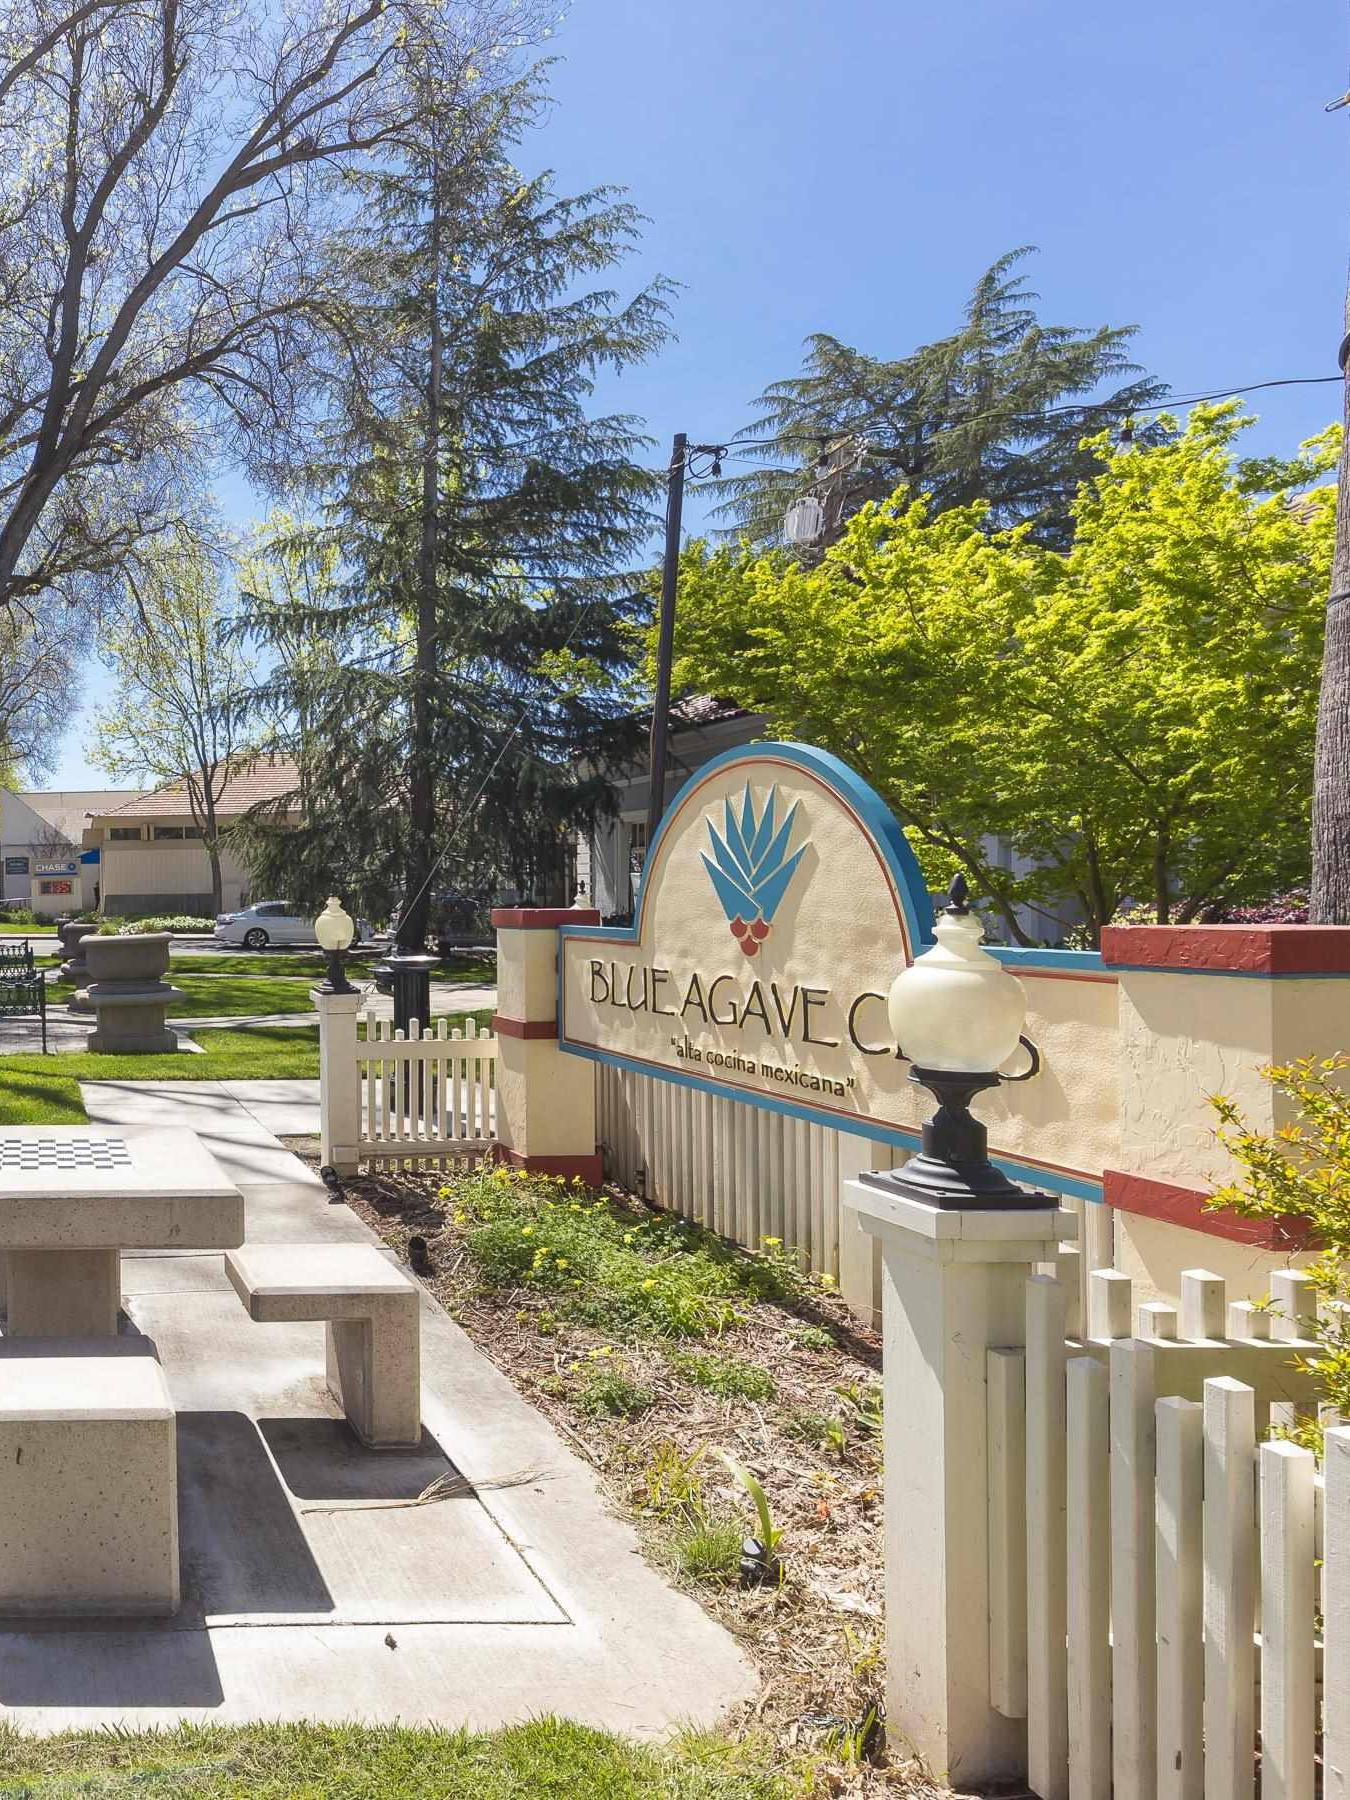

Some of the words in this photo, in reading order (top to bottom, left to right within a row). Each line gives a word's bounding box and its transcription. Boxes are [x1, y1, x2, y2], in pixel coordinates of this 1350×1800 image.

[36, 864, 66, 872] CHASE
[590, 960, 675, 1016] BLUE
[680, 972, 839, 1048] AGAVE
[706, 1050, 756, 1074] cocina
